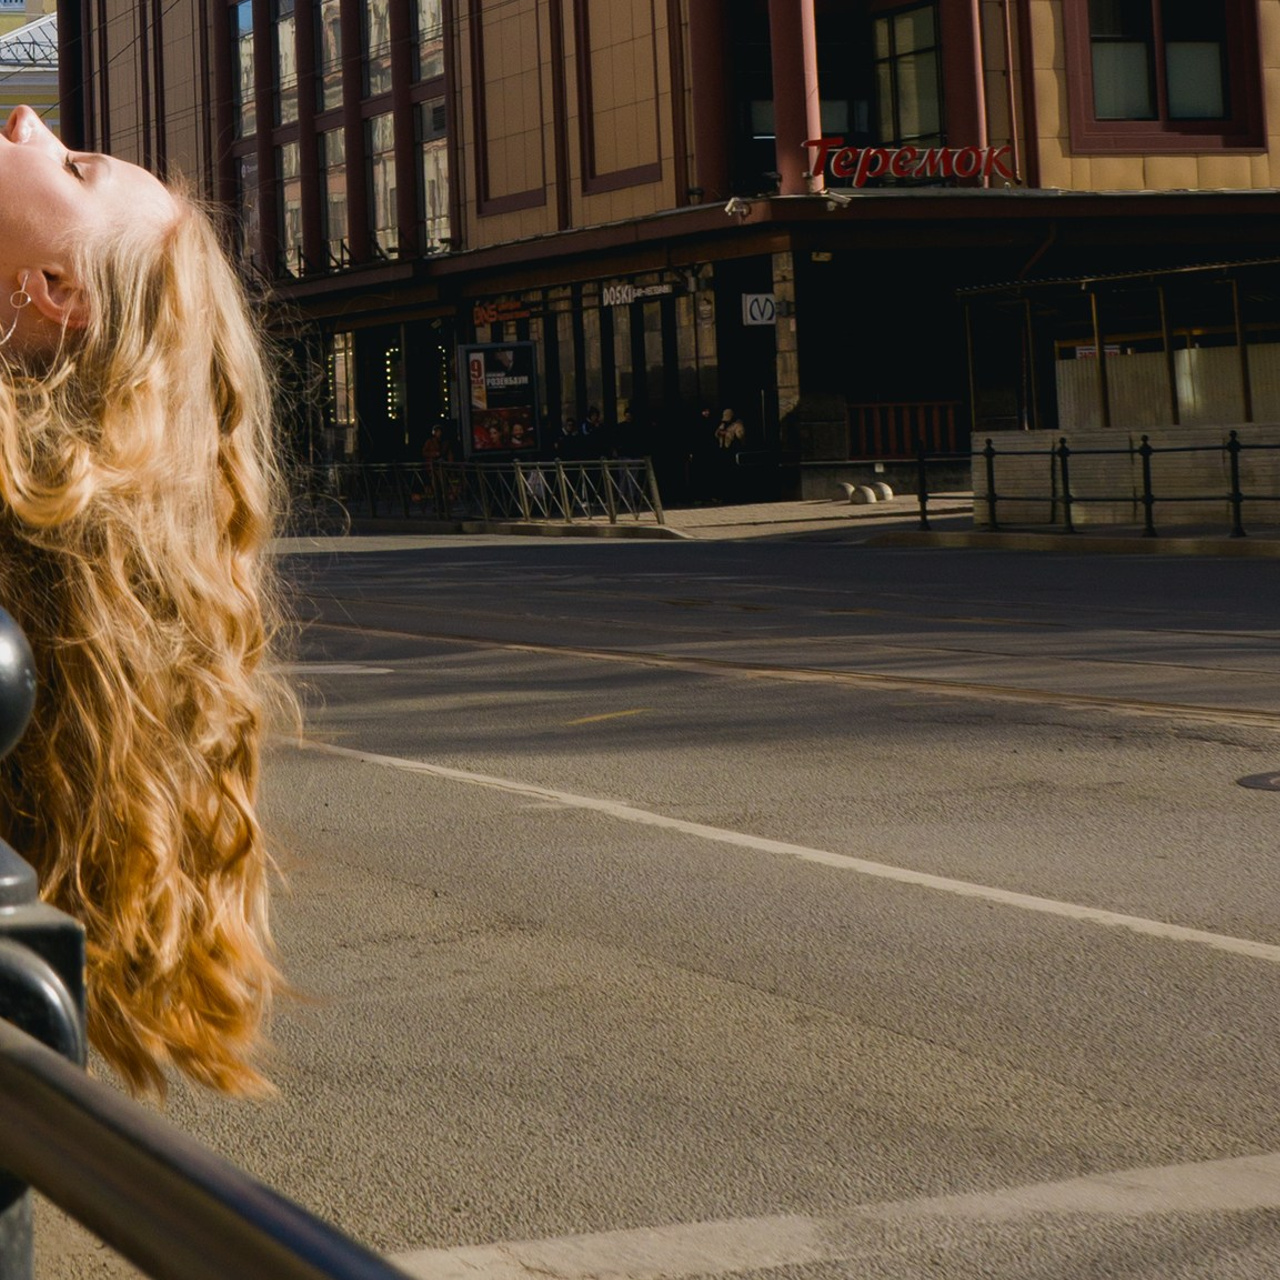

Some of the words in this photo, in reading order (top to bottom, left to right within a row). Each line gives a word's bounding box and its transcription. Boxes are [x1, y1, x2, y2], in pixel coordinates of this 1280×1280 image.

[801, 137, 1014, 188] Теремок
[603, 284, 633, 307] DOSKI
[471, 359, 482, 379] 9
[486, 375, 529, 387] РОЗЕНБАУМ
